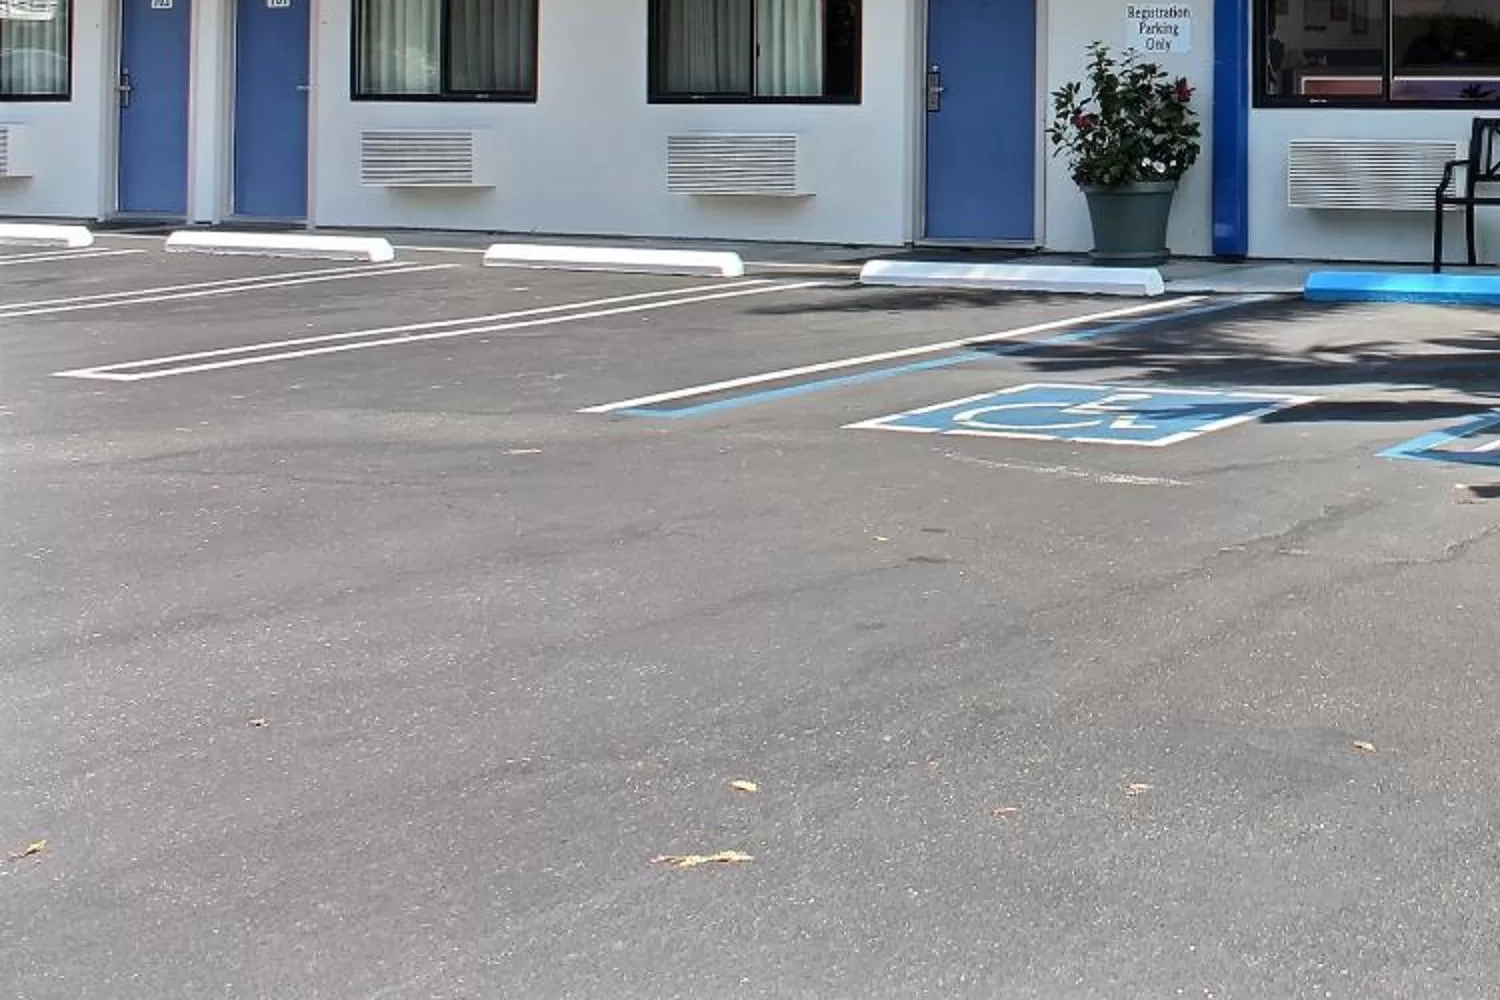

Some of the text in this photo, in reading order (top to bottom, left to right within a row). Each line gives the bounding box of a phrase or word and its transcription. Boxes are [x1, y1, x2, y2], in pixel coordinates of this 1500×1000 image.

[1127, 5, 1191, 20] Registration
[1139, 21, 1179, 36] Parking
[1146, 37, 1172, 52] Only
